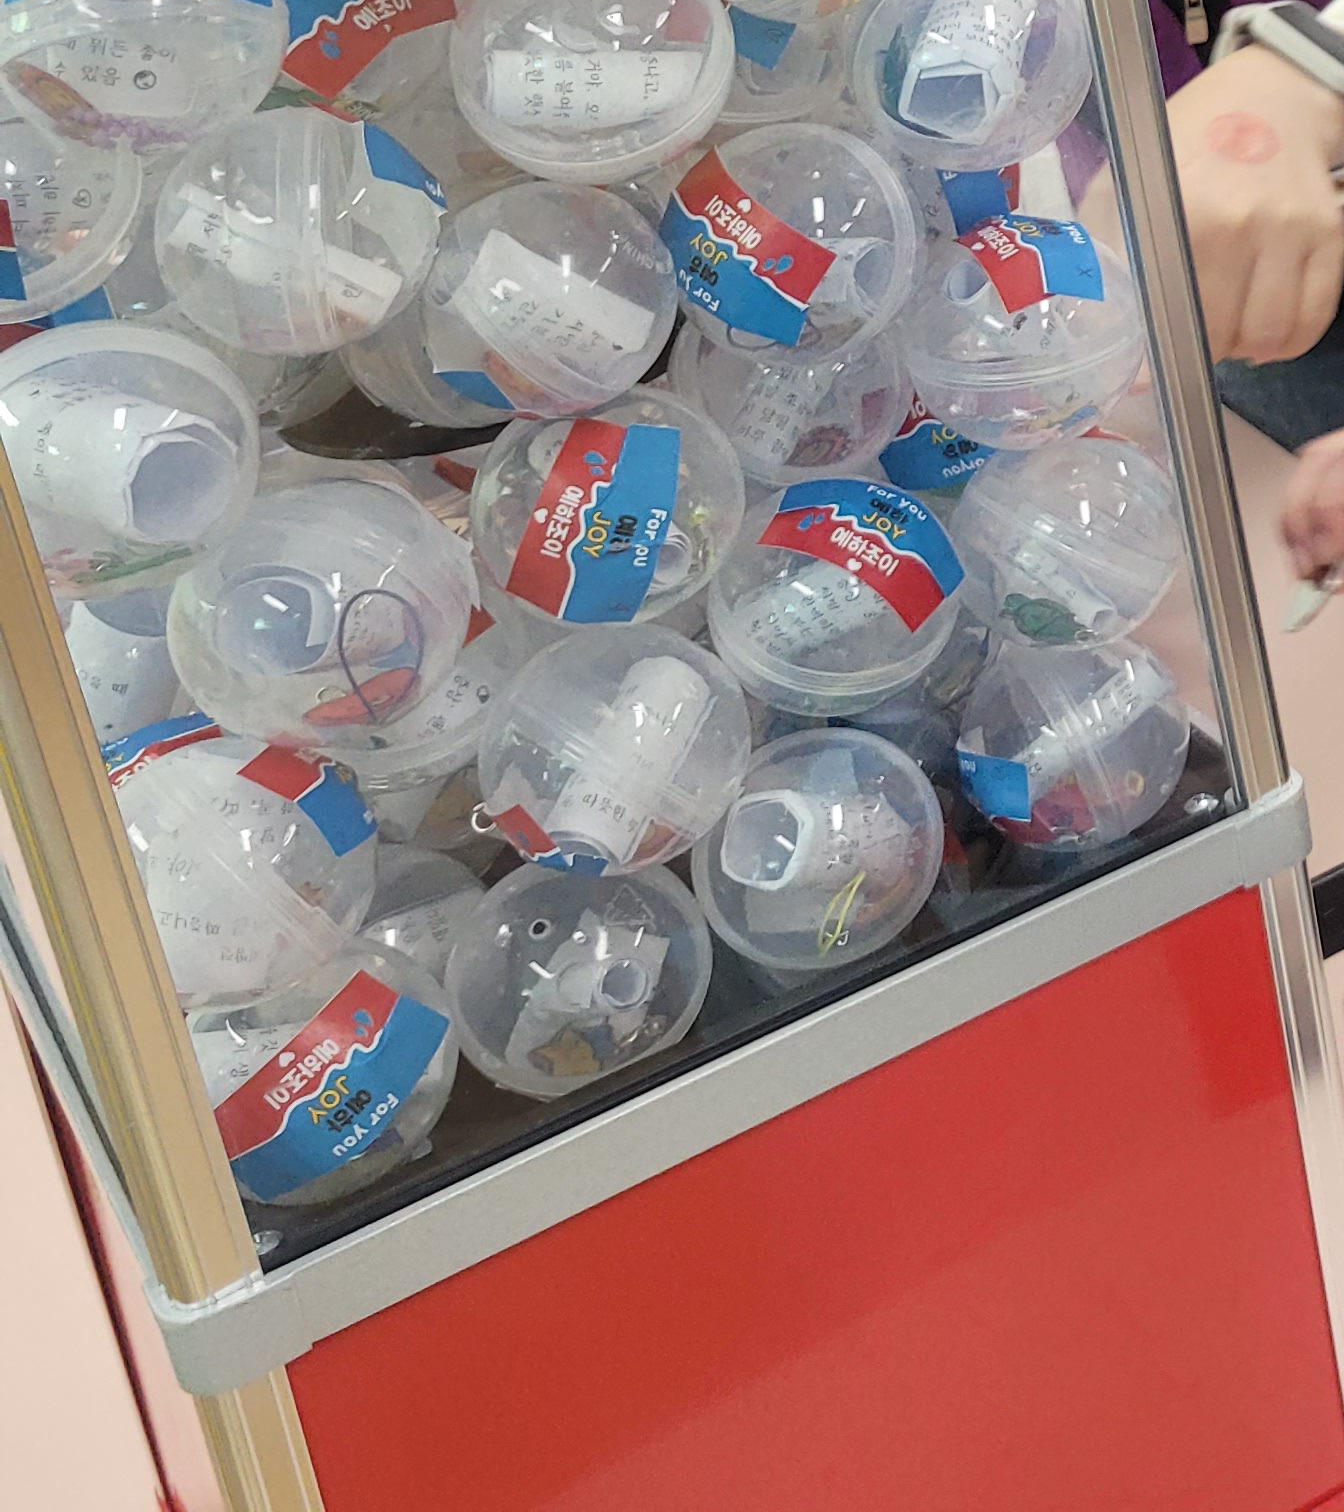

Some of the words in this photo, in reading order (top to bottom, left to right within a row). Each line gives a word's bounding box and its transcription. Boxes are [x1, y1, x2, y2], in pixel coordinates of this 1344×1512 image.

[703, 194, 762, 250] 예하조이
[1013, 220, 1043, 239] JOY
[689, 232, 729, 265] JOY
[693, 287, 721, 312] For
[867, 484, 897, 499] For
[899, 498, 928, 521] you
[540, 485, 585, 558] 예하조이
[582, 511, 611, 558] JOY
[645, 508, 668, 541] For
[862, 512, 906, 539] JOY
[830, 527, 899, 576] 예하조이
[263, 1039, 340, 1111] 예하조이
[307, 1075, 349, 1125] JOY
[326, 1089, 372, 1132] 예하
[370, 1093, 399, 1126] For
[332, 1123, 369, 1157] you
